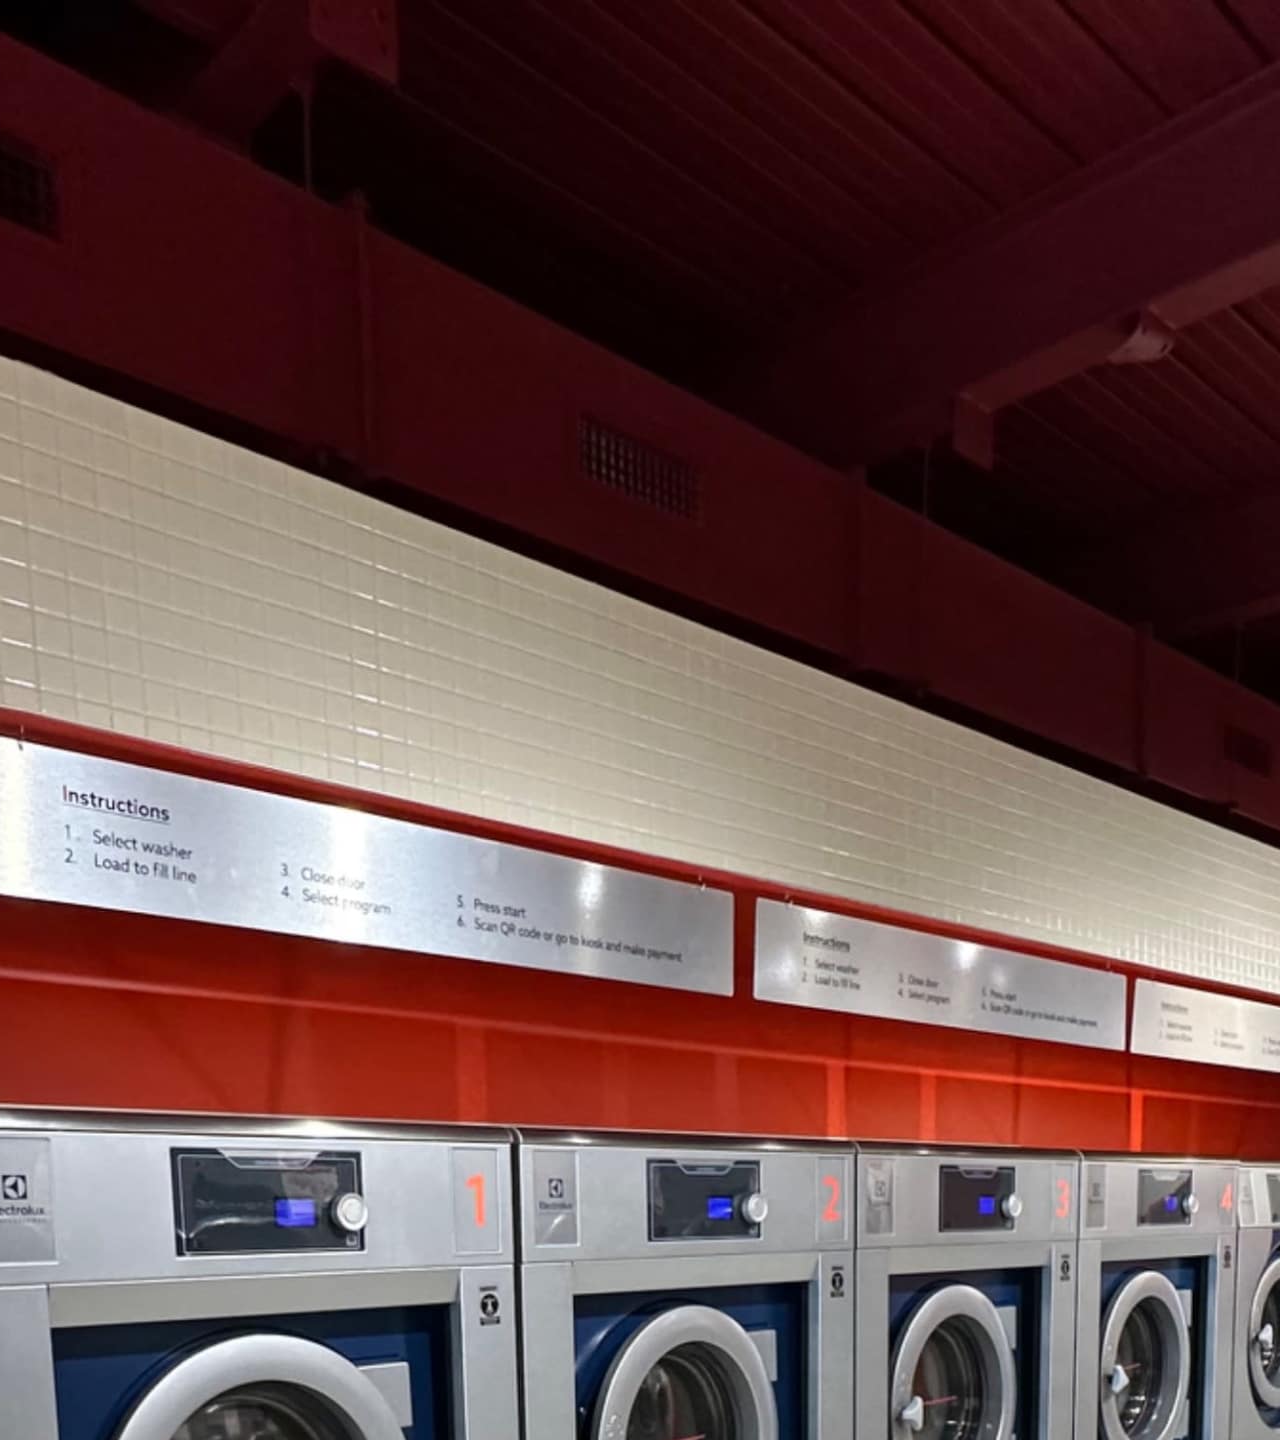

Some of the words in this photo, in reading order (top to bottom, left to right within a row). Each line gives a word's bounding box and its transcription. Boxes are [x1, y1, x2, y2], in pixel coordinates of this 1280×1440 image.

[62, 785, 170, 821] Instructions
[93, 829, 137, 850] Select
[142, 841, 192, 860] washer
[94, 853, 130, 873] Load
[135, 862, 149, 875] to
[153, 862, 169, 879] fill
[173, 866, 197, 883] line
[301, 866, 334, 884] Close
[302, 888, 339, 906] Select
[342, 897, 392, 914] program
[474, 898, 501, 914] Press
[504, 905, 526, 918] start
[474, 918, 498, 932] Scan
[500, 921, 516, 936] QR
[519, 927, 541, 941] code
[544, 932, 553, 941] or
[556, 935, 568, 946] go
[570, 934, 579, 946] to
[581, 937, 603, 949] kiosk
[605, 941, 621, 952] and
[647, 949, 682, 963] payment
[465, 1174, 485, 1227] 1
[822, 1175, 841, 1223] 2
[1055, 1180, 1069, 1218] 3
[1220, 1183, 1232, 1212] 4
